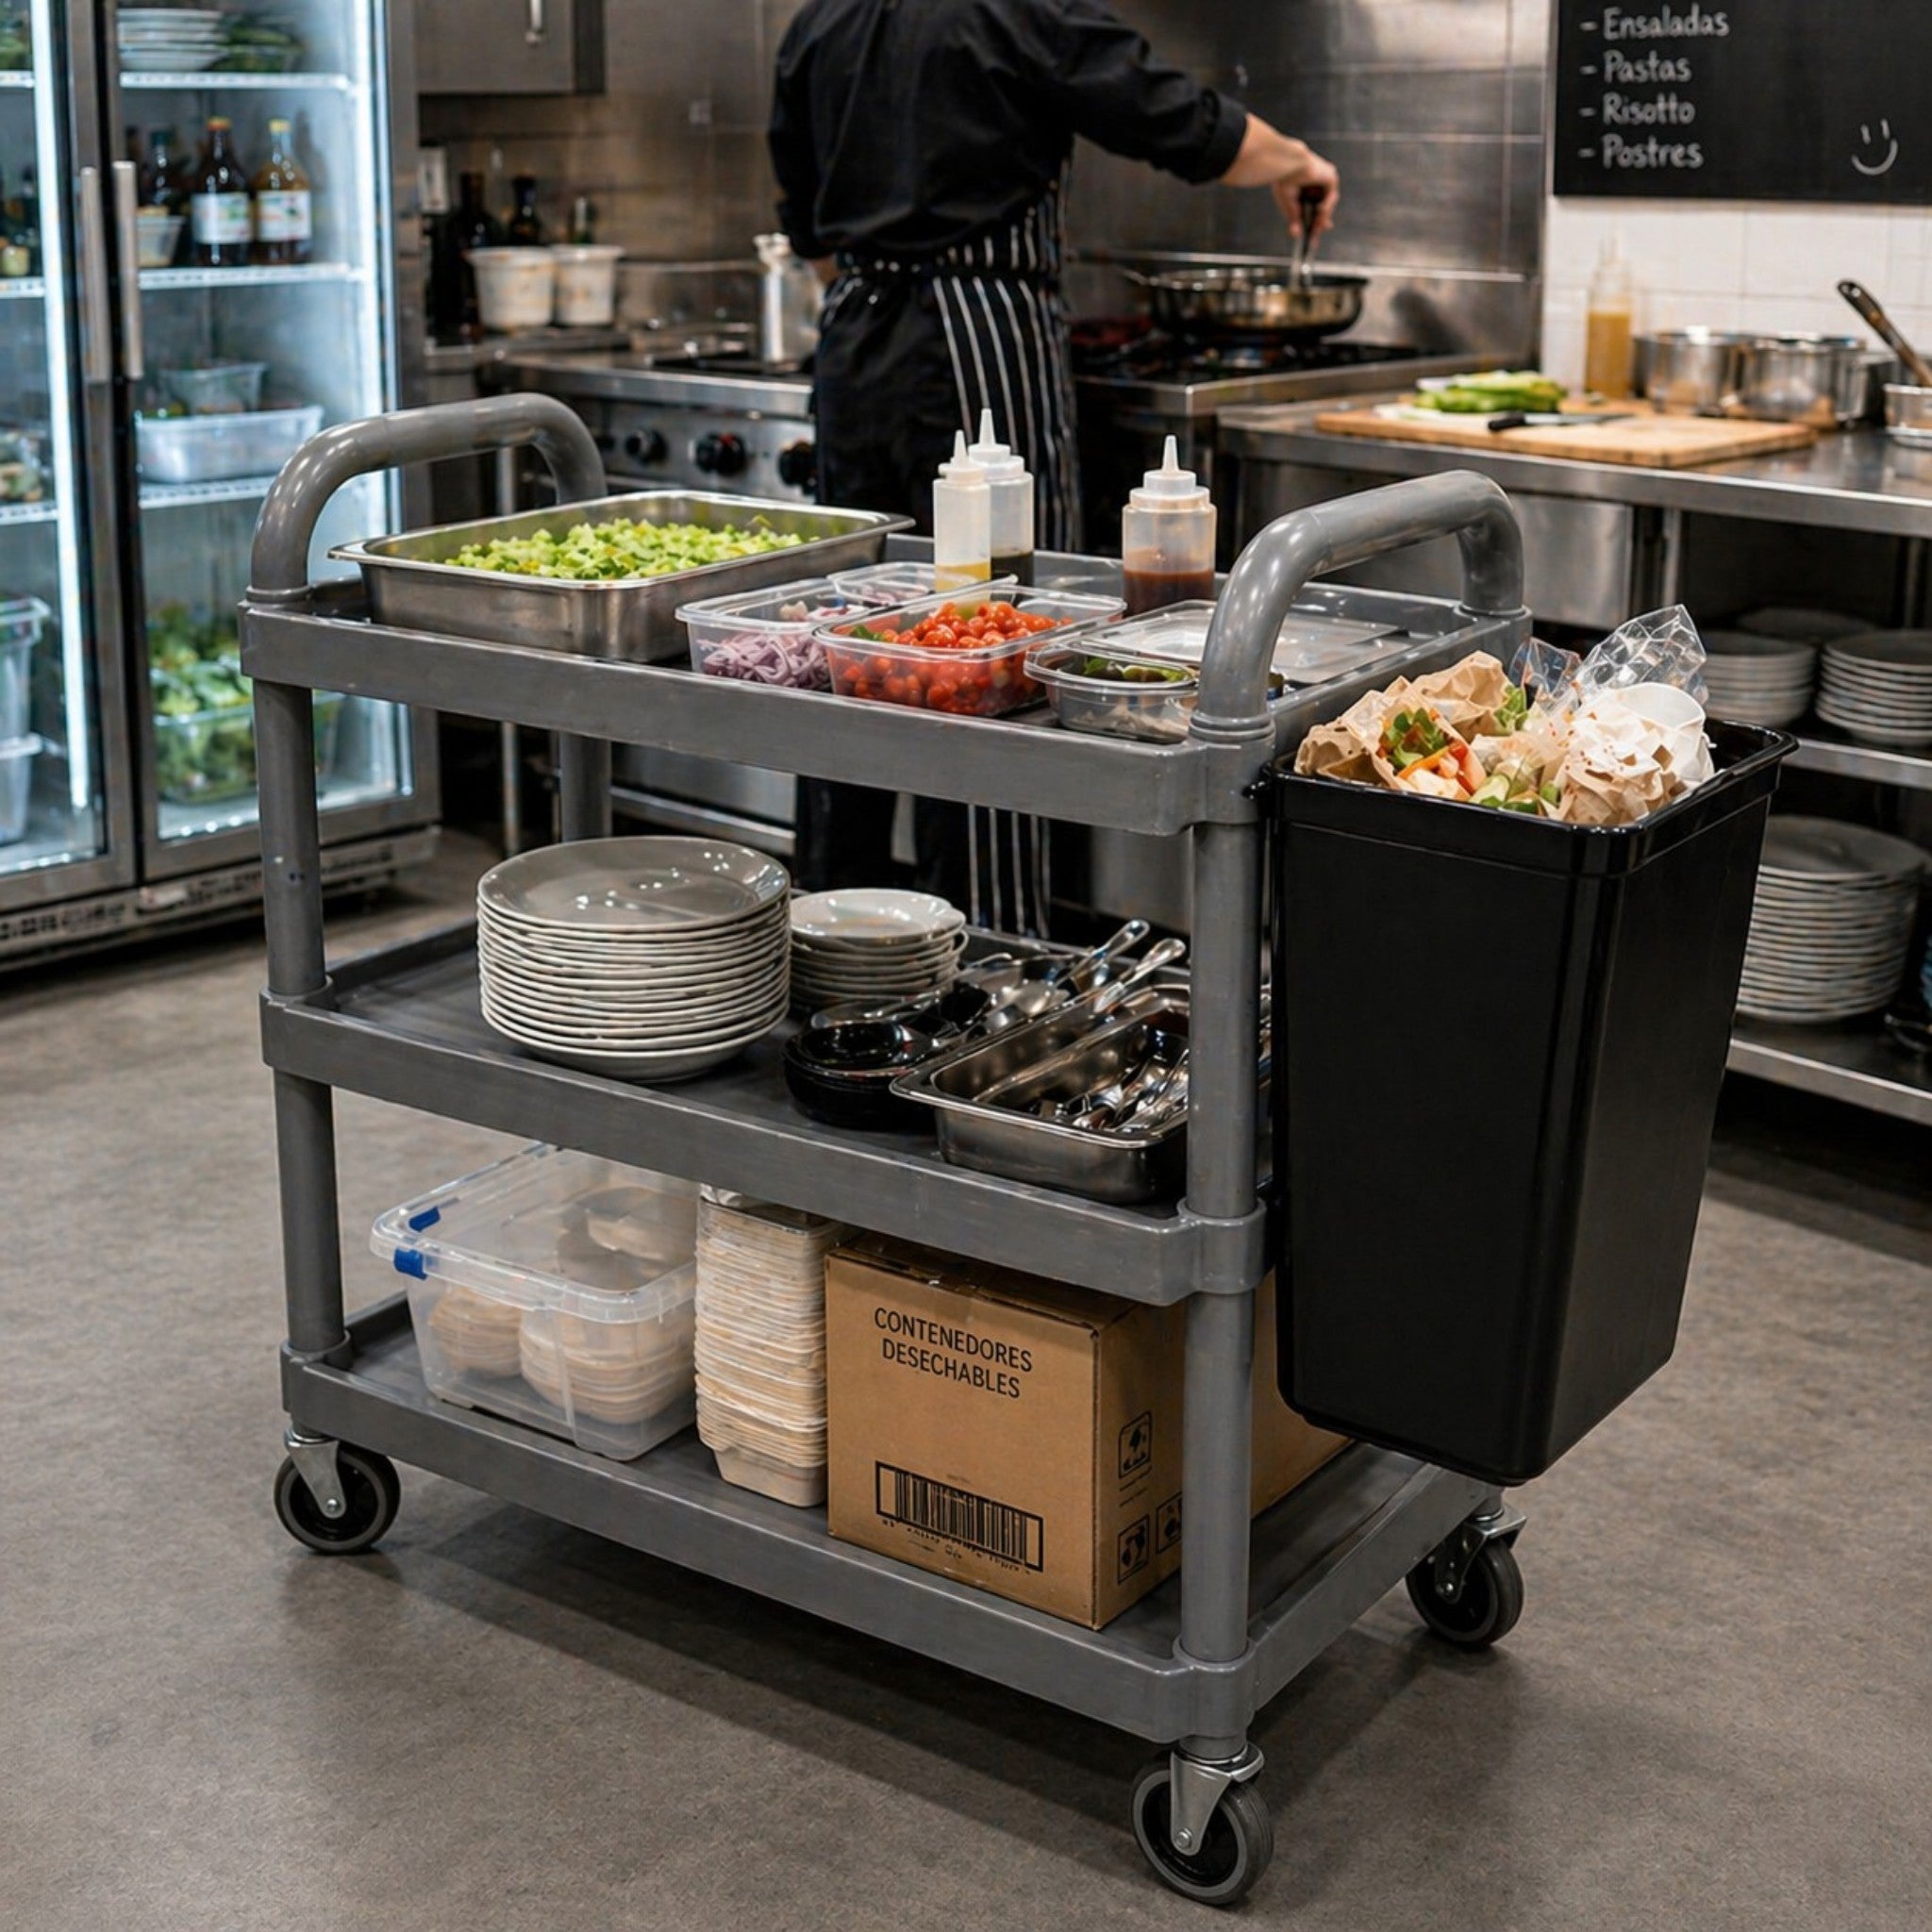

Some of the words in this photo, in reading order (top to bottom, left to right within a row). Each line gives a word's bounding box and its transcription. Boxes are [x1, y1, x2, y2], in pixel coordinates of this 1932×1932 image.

[1604, 3, 1730, 41] Ensaladas
[1604, 49, 1692, 83] Pastas
[1603, 92, 1695, 125] Risotto
[1602, 133, 1704, 168] Postres
[874, 1307, 1033, 1373] CONTENEDORES
[882, 1338, 1021, 1399] DESECHABLES
